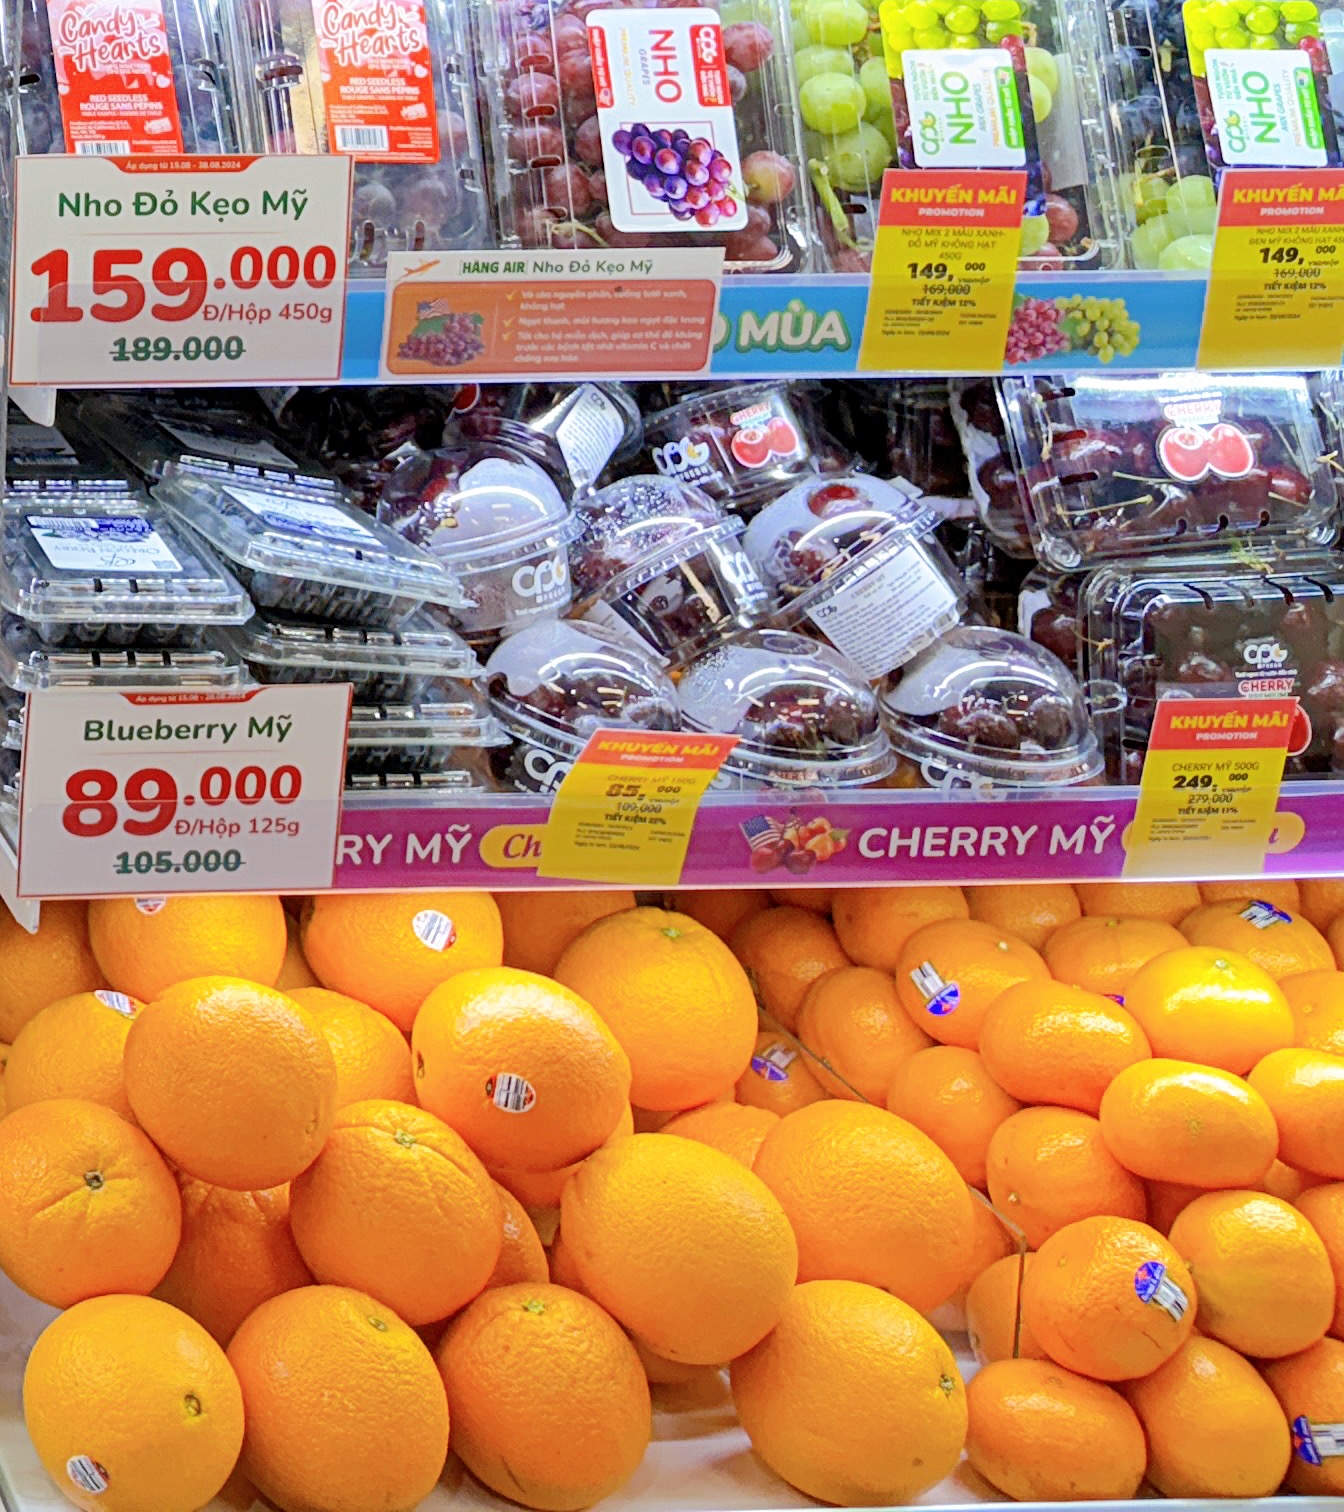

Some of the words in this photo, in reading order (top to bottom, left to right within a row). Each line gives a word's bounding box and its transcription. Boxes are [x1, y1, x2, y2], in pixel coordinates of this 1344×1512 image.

[336, 25, 422, 67] Hearts
[648, 29, 683, 104] NHO
[1241, 70, 1281, 144] NHO
[57, 191, 123, 218] Nho
[131, 188, 179, 218] Đỏ
[190, 190, 251, 223] Kẹo
[261, 188, 309, 221] Mỹ
[29, 244, 338, 323] 159.000
[201, 302, 272, 325] Đ/Hộp
[278, 302, 333, 324] 450g
[740, 300, 849, 347] MÙA
[109, 334, 247, 363] 189.000
[83, 717, 237, 745] Blueberry
[247, 714, 293, 743] Mỹ
[61, 764, 303, 839] 89.000
[174, 817, 241, 839] Đ/Hộp
[247, 817, 300, 838] 125g
[857, 824, 1040, 859] CHERRY
[1048, 814, 1118, 856] MỸ
[112, 849, 247, 875] 105.000
